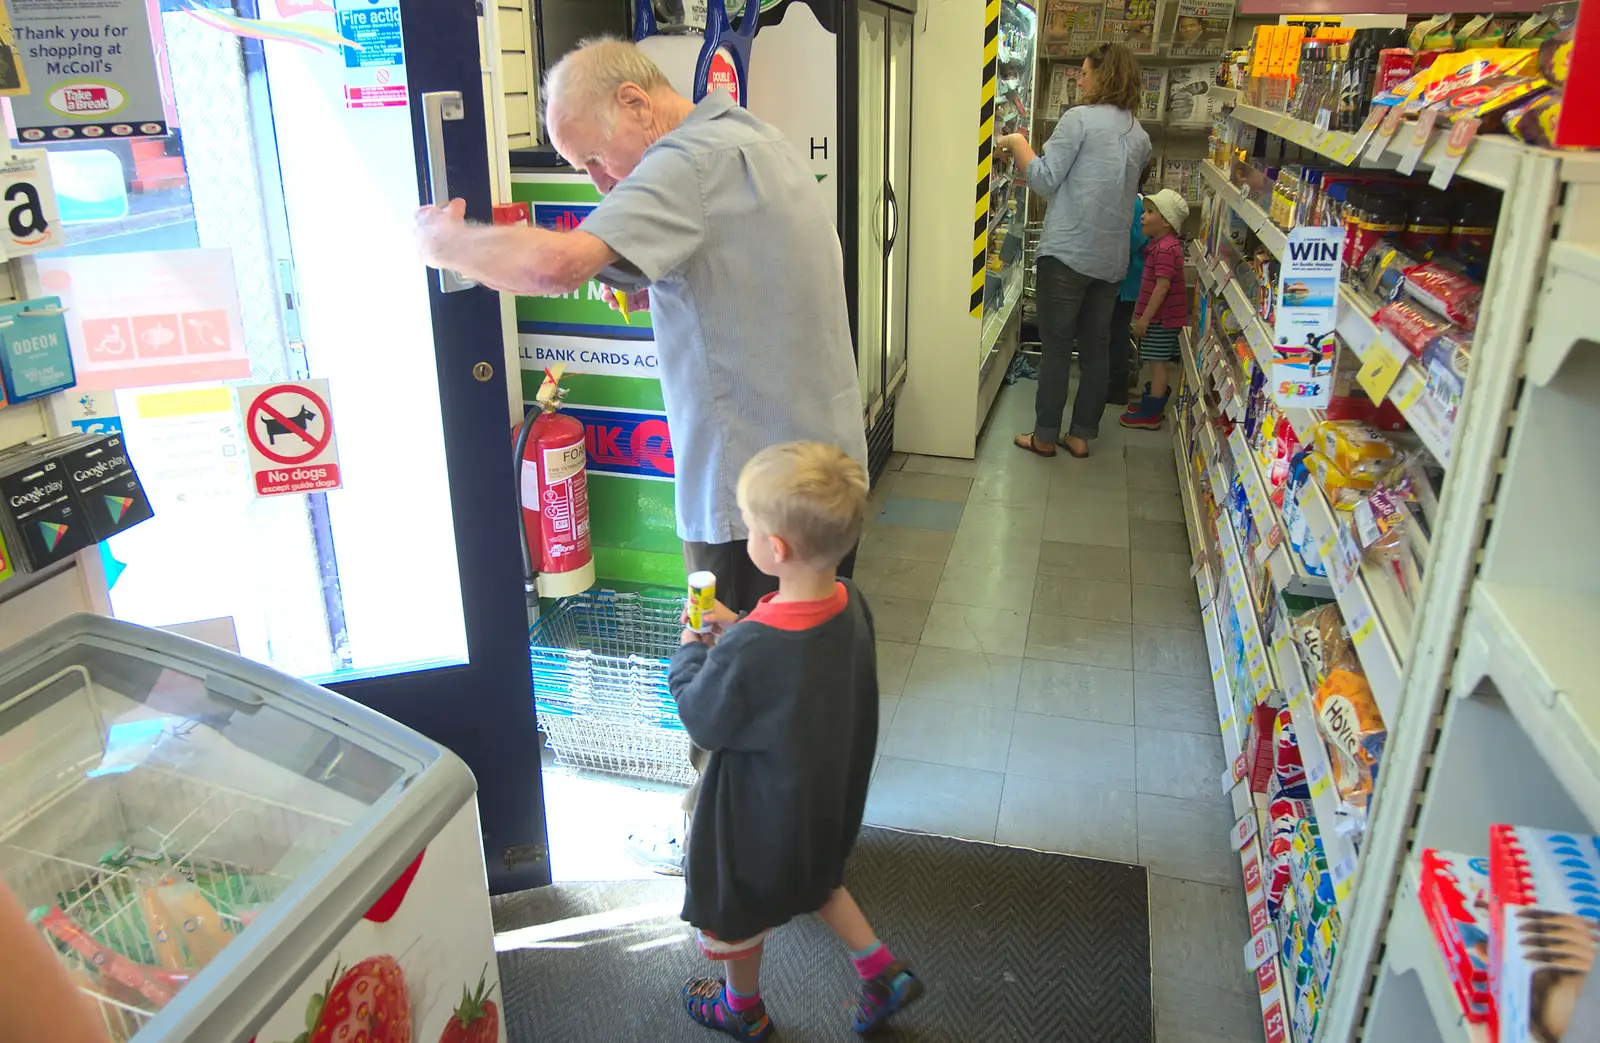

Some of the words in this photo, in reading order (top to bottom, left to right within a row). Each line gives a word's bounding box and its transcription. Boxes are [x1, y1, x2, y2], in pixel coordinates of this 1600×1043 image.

[341, 10, 367, 26] Fire
[370, 7, 400, 24] actio
[14, 26, 65, 40] Thank
[70, 28, 99, 41] you
[104, 25, 128, 37] for
[30, 44, 102, 59] shopping
[107, 43, 121, 55] at
[47, 60, 112, 74] McColl's
[712, 71, 730, 82] DOUBLE
[65, 90, 92, 101] Take
[75, 99, 108, 110] Break
[810, 137, 827, 160] H
[4, 182, 48, 238] a
[1289, 242, 1339, 261] WIN
[13, 333, 58, 355] ODEON
[519, 346, 532, 359] LL
[536, 347, 575, 362] BANK
[580, 351, 629, 365] CARDS
[634, 355, 659, 368] AC
[108, 438, 119, 447] £25
[44, 462, 56, 472] £25
[73, 461, 108, 482] Google
[108, 455, 126, 469] play
[267, 470, 289, 483] No
[291, 468, 327, 481] dogs
[10, 487, 45, 507] Google
[45, 480, 63, 494] play
[262, 484, 290, 494] except
[291, 481, 314, 491] guide
[316, 479, 336, 488] dogs
[1246, 864, 1259, 885] £1
[1252, 908, 1266, 930] £1
[1267, 1011, 1284, 1038] £1
